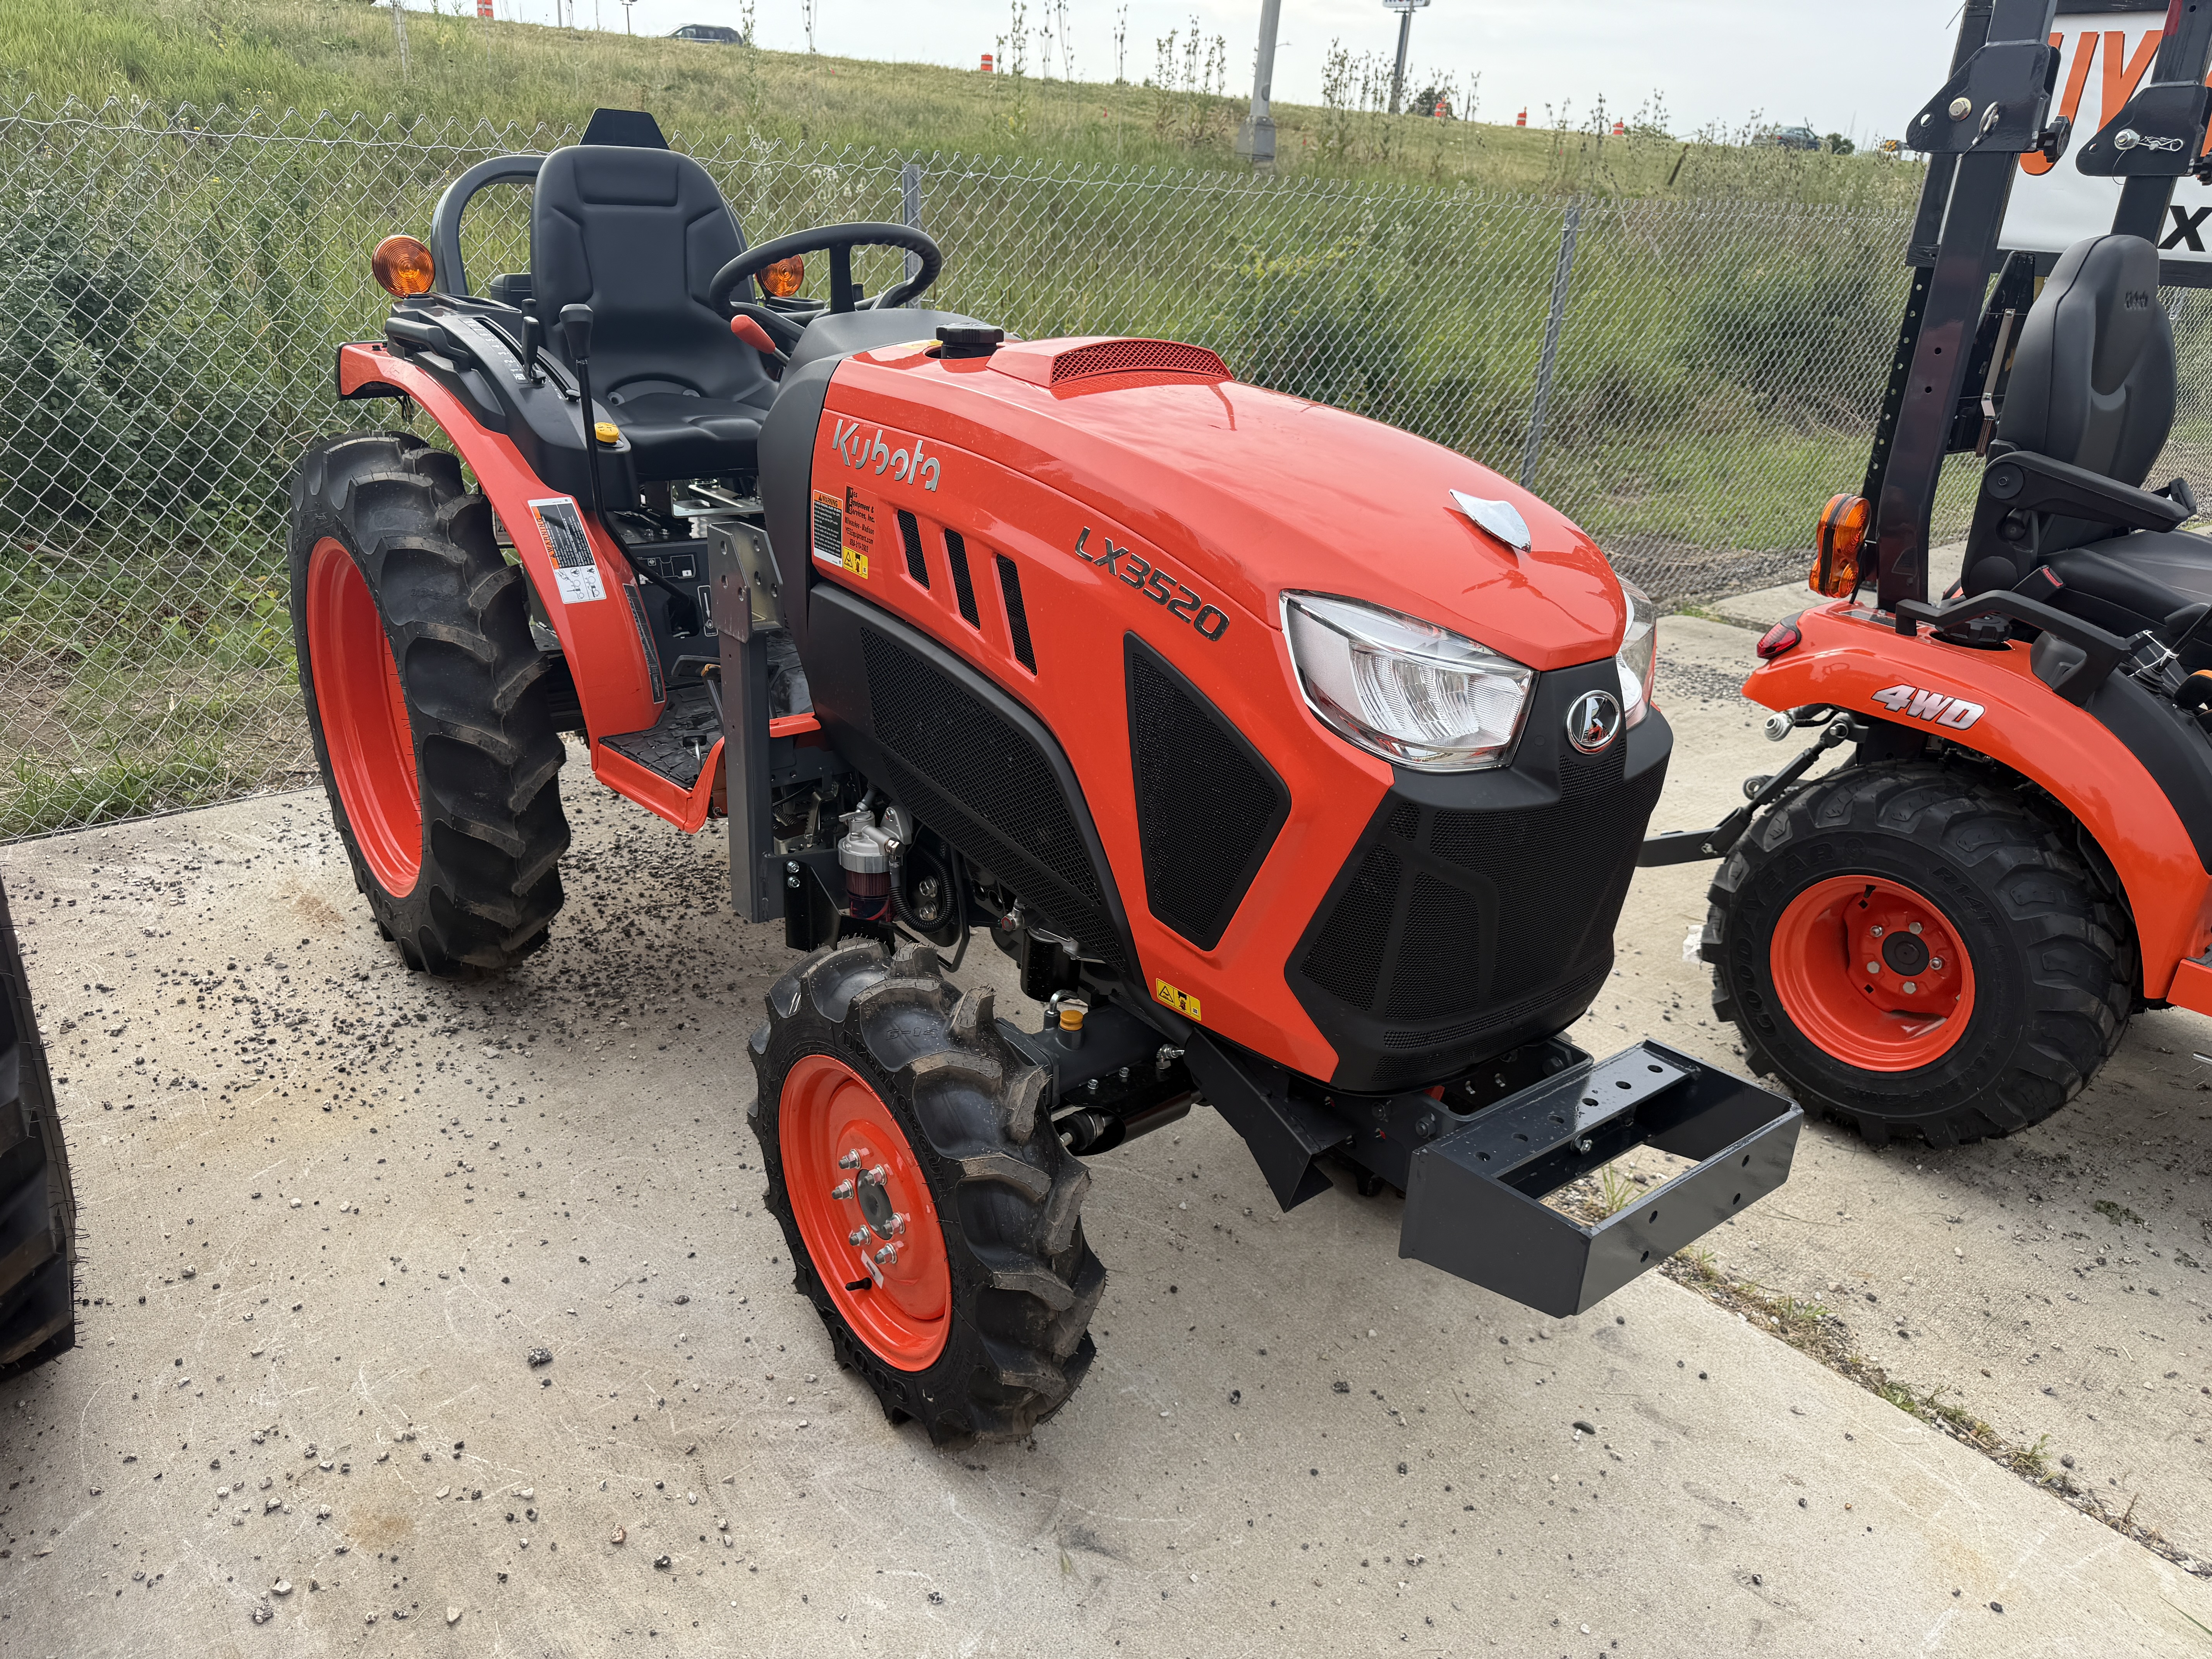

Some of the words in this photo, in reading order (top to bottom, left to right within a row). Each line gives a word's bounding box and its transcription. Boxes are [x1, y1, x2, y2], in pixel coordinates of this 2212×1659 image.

[832, 419, 940, 492] Kubota
[821, 495, 838, 507] WARNING
[536, 517, 553, 552] WARNING
[1075, 526, 1230, 642] LX3520
[1870, 683, 1985, 731] 4WD
